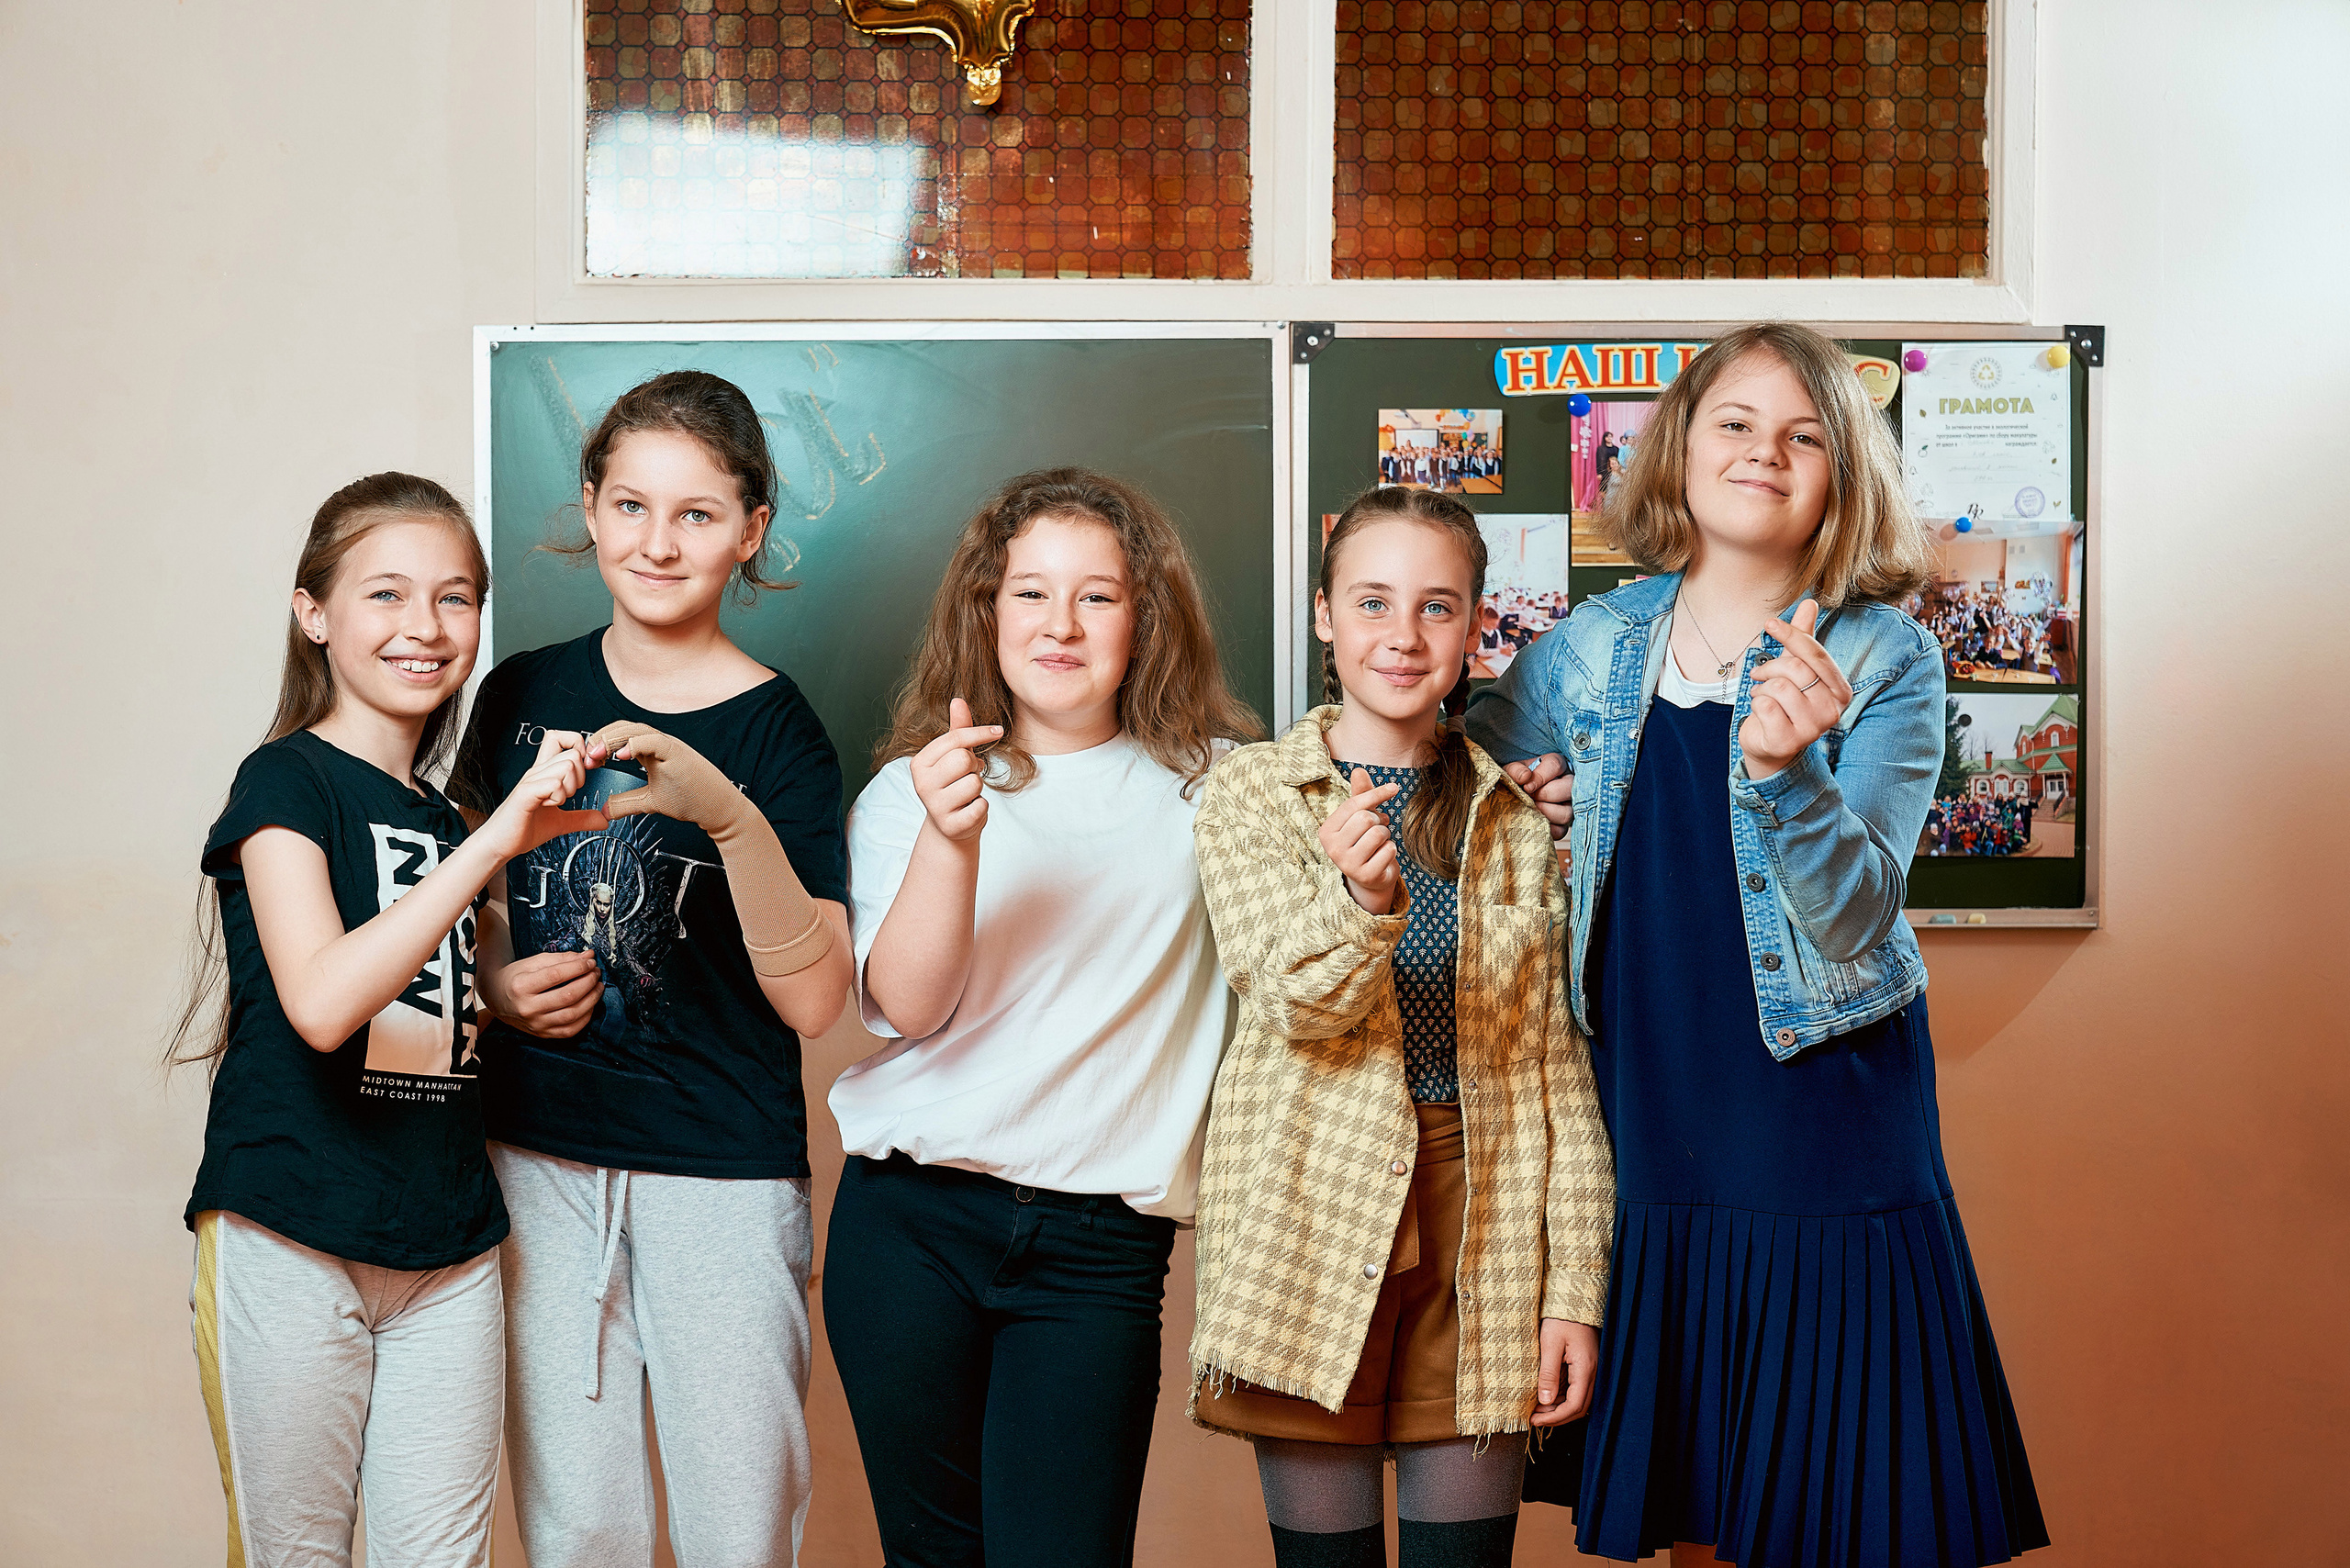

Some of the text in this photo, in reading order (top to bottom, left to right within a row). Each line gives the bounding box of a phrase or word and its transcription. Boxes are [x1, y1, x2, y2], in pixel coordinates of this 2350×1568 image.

[1502, 343, 1662, 395] НАШ
[1939, 398, 2035, 415] ГРАМОТА
[362, 1075, 463, 1092] MIDTOWN MANHATTAN
[360, 1085, 446, 1103] EAST COAST 1998
